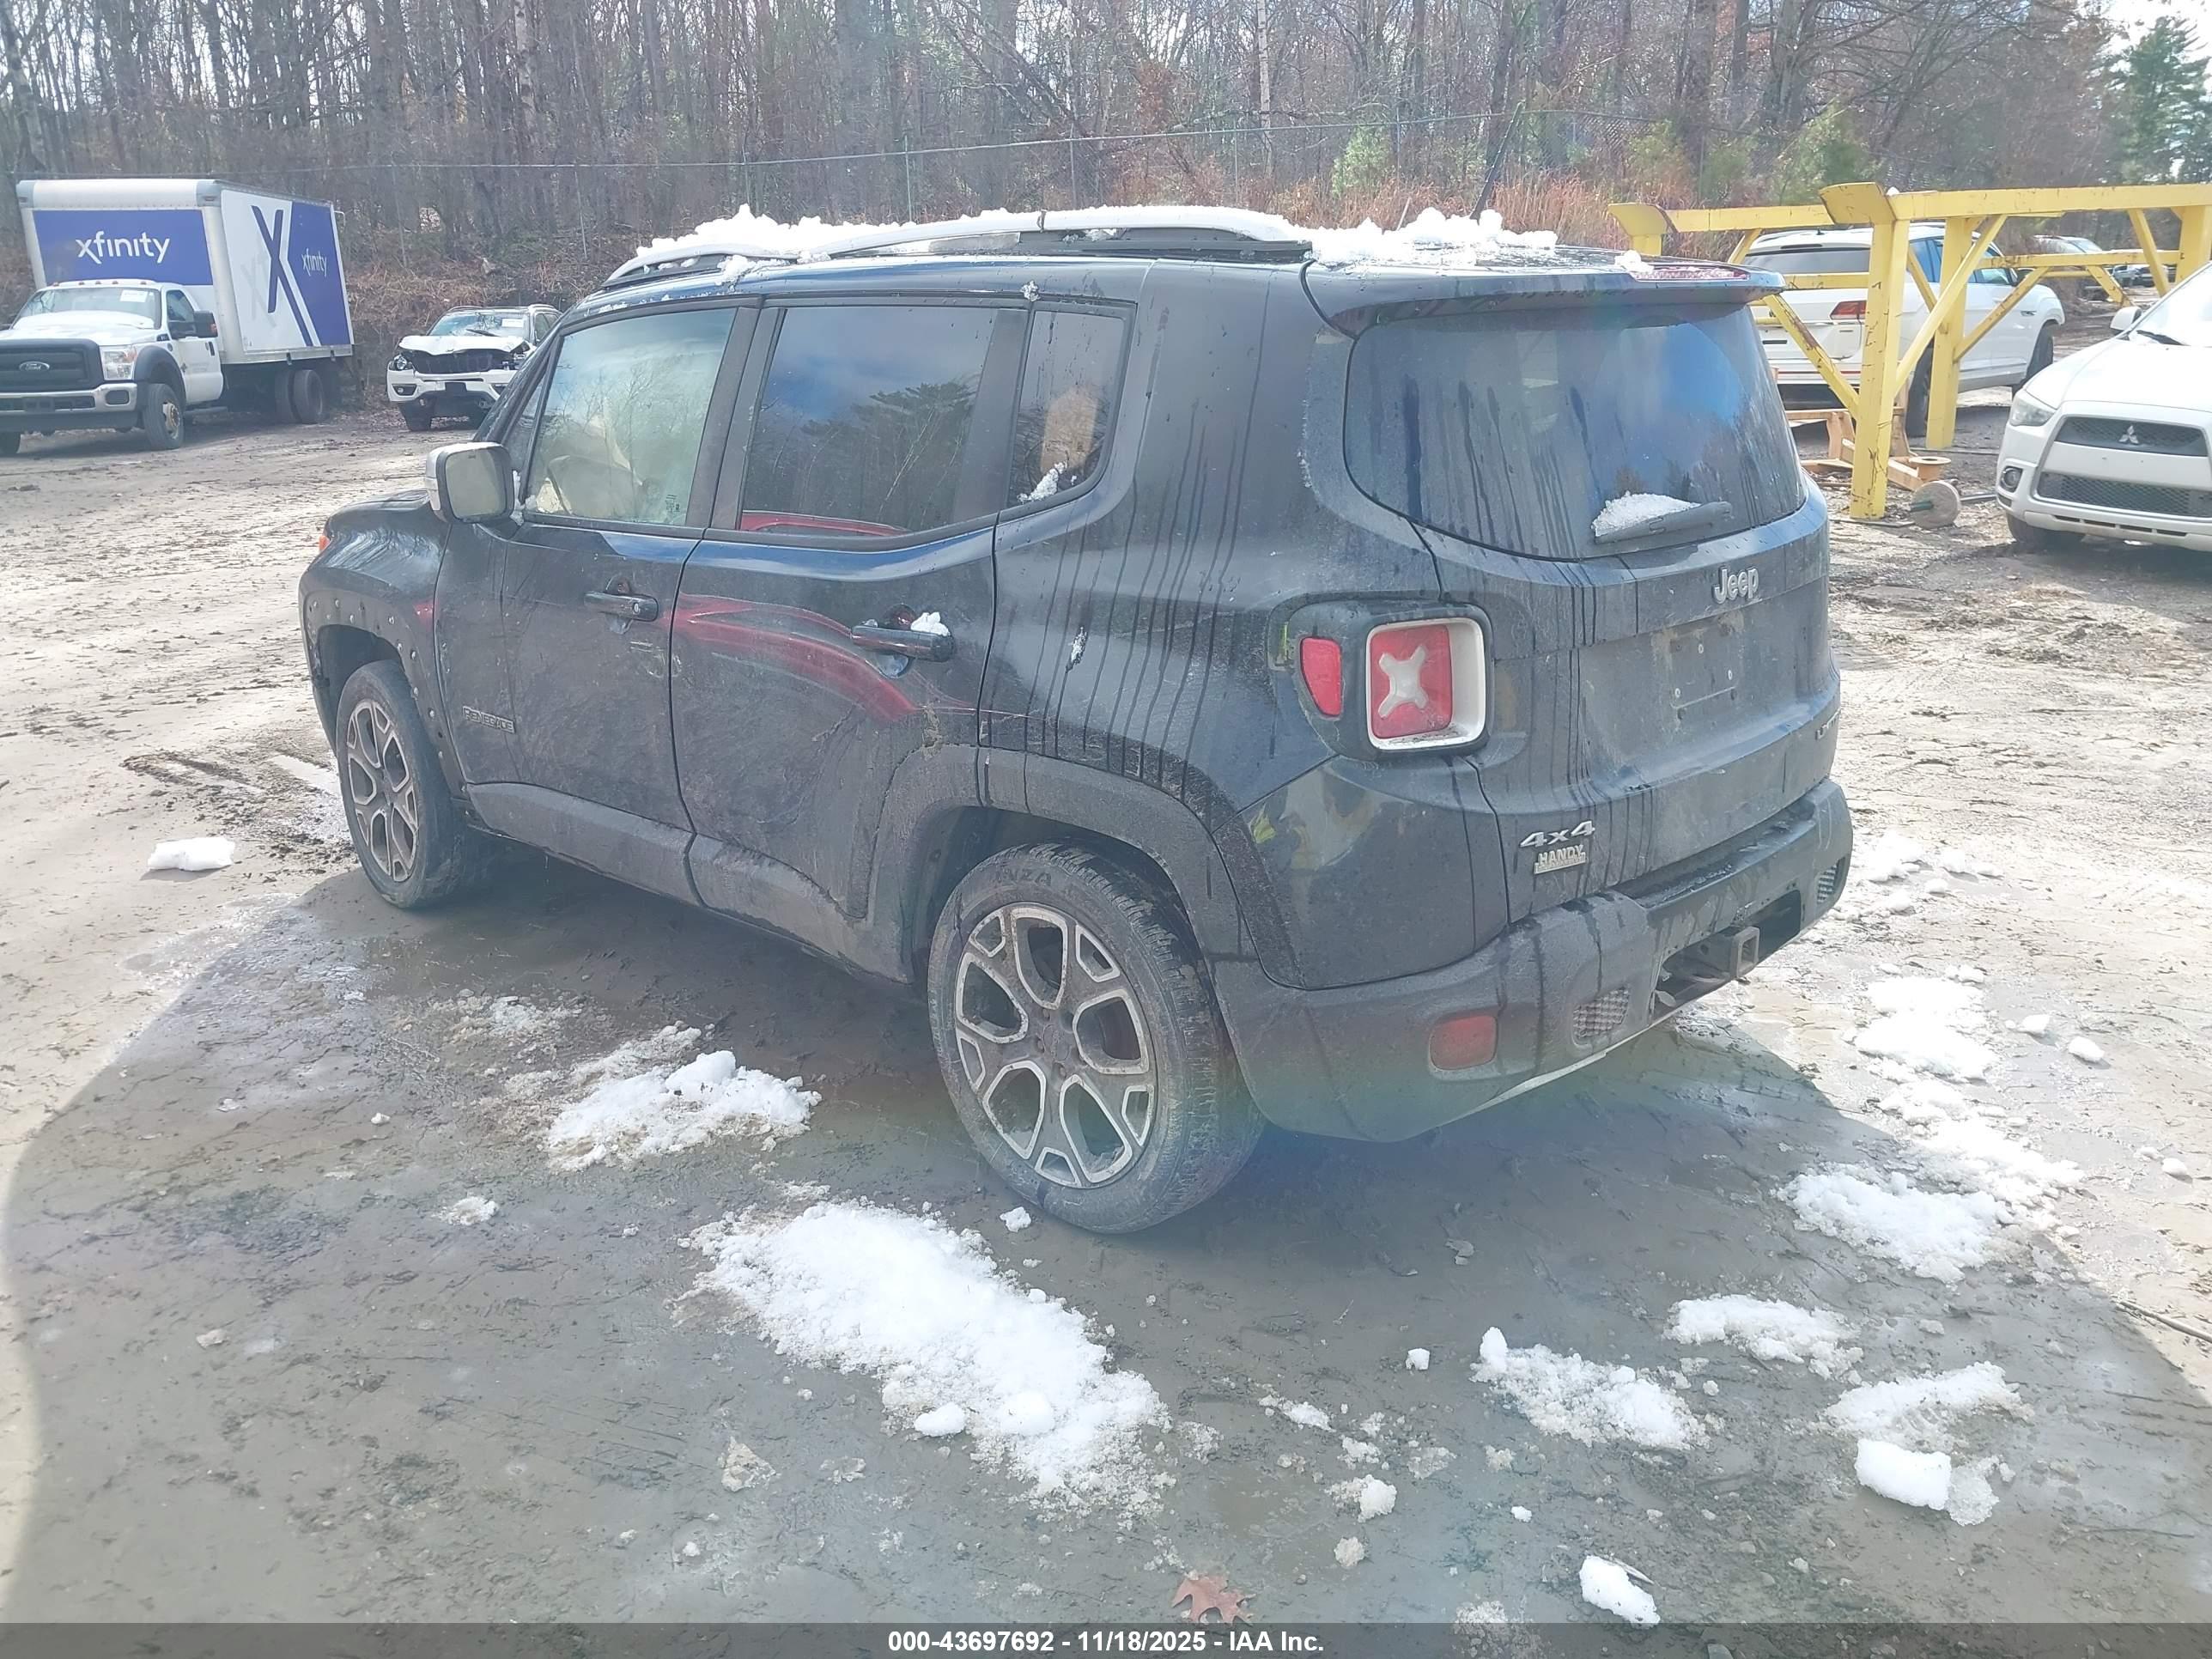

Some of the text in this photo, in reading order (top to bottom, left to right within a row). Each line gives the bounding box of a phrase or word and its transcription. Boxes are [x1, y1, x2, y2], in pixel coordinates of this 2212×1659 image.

[75, 230, 170, 264] xfinity
[301, 247, 327, 276] xfinity
[1713, 567, 1759, 605] Jeep
[462, 705, 515, 734] RENEGADE
[1520, 820, 1595, 848] 4x4
[1537, 844, 1584, 865] HANDY
